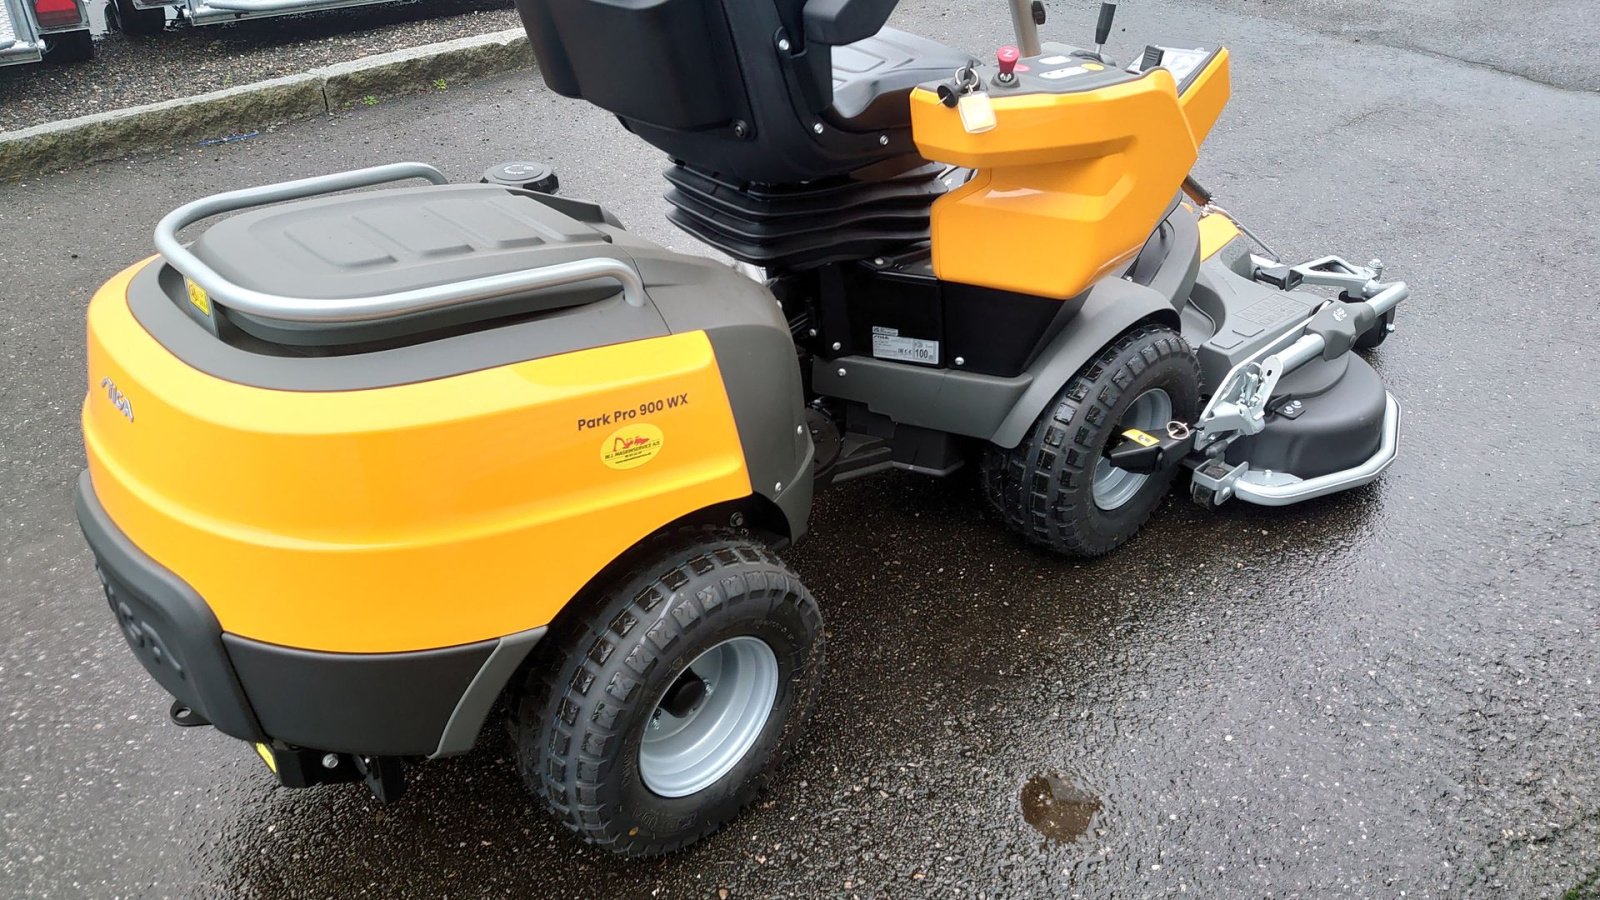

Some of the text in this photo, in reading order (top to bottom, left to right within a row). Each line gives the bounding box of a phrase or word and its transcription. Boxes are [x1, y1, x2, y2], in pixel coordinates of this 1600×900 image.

[915, 348, 929, 359] 100
[577, 393, 688, 431] Park Pro 900 WX
